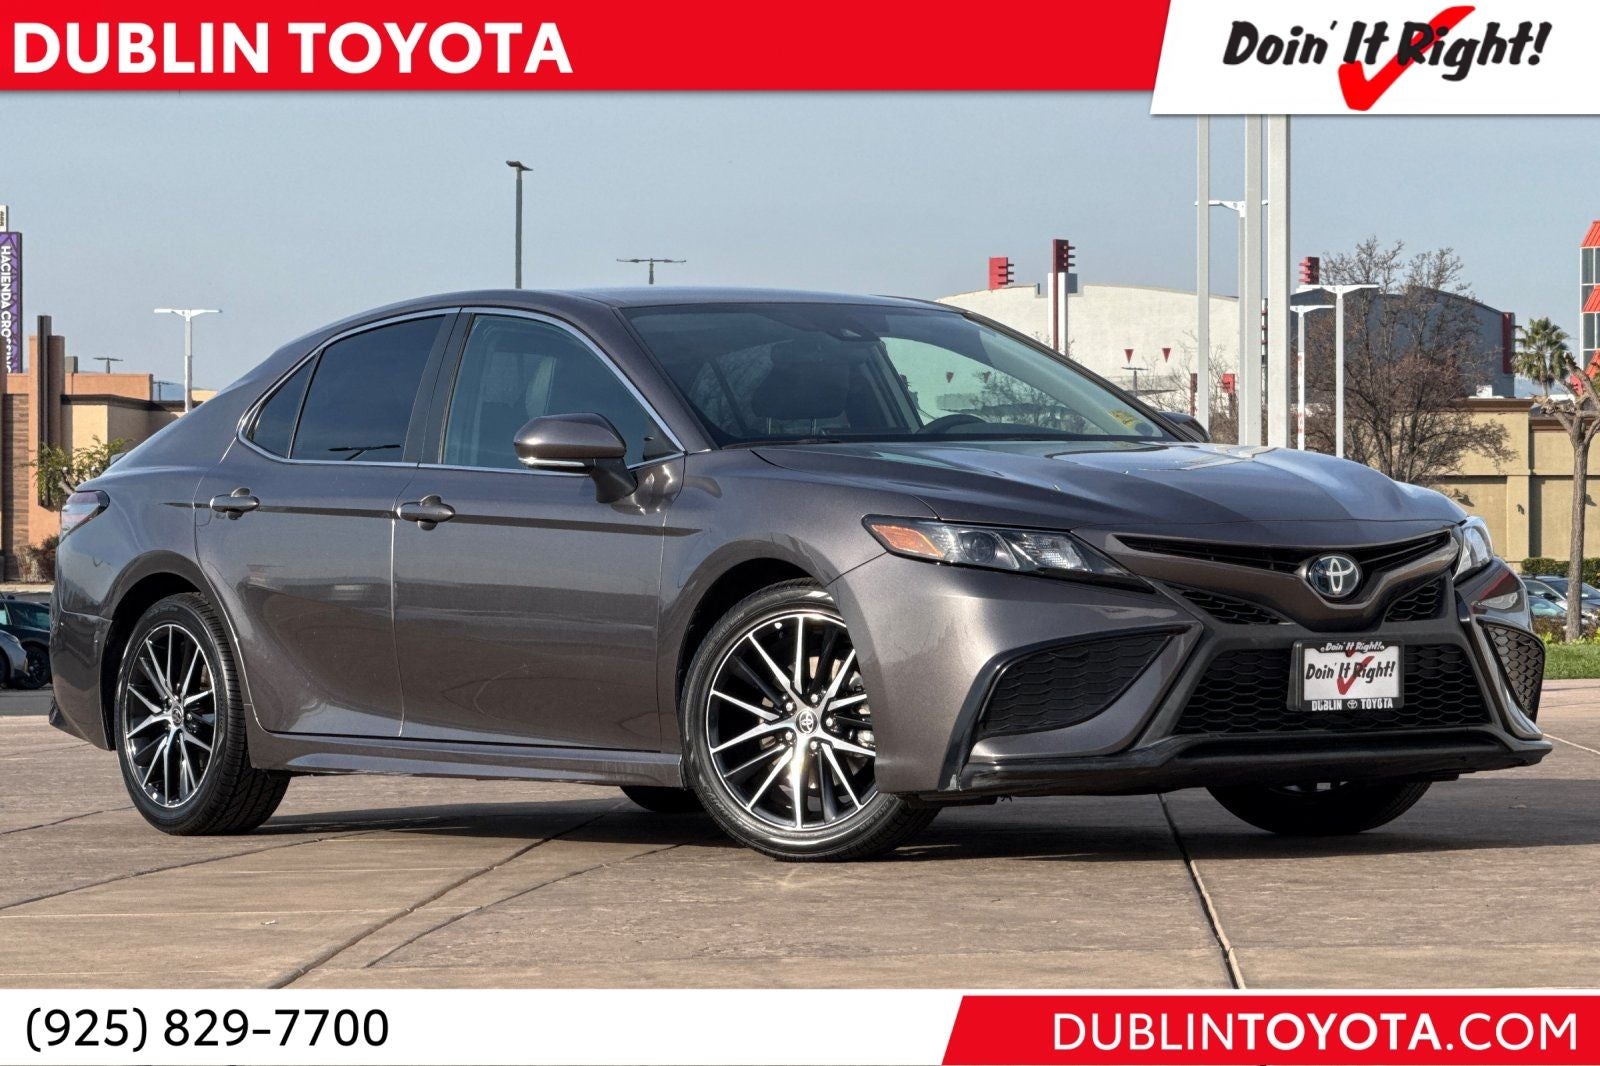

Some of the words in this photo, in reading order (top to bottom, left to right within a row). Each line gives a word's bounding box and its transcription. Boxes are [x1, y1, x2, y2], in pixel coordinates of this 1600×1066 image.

[1, 246, 11, 309] HACIENDA
[1346, 642, 1356, 651] It
[1305, 662, 1337, 680] Doin'
[1339, 662, 1350, 678] It
[1353, 661, 1396, 684] Right!
[1311, 700, 1342, 711] DUBLIN
[1361, 698, 1393, 710] TOYOTA
